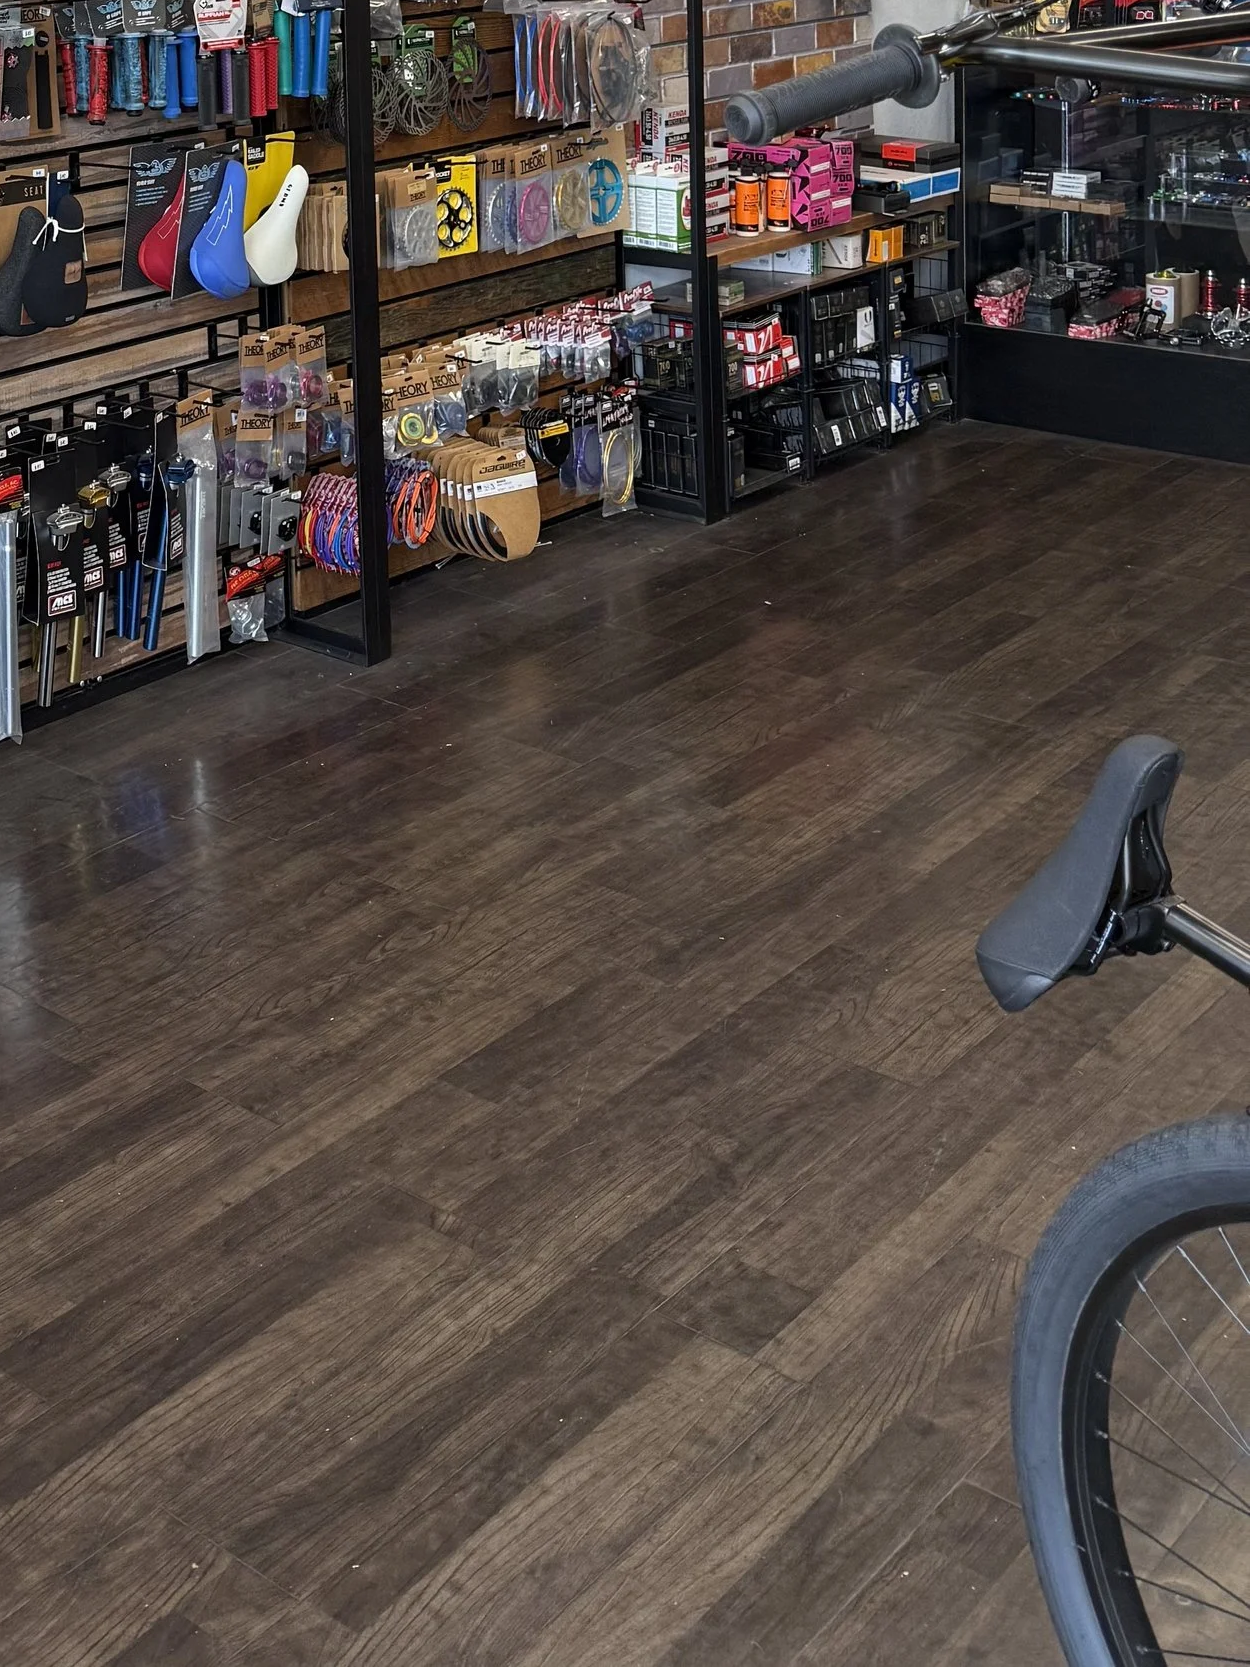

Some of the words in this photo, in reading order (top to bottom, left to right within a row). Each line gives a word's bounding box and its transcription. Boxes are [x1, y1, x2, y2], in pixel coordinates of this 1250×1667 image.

[668, 109, 687, 118] KENDA
[556, 145, 582, 161] THEORY
[520, 152, 546, 171] THEORY
[833, 173, 853, 182] 700
[24, 185, 43, 197] SEAT
[245, 345, 263, 355] THEO
[299, 336, 325, 353] THEORY
[432, 372, 458, 388] HEORY
[241, 419, 271, 428] THEORY
